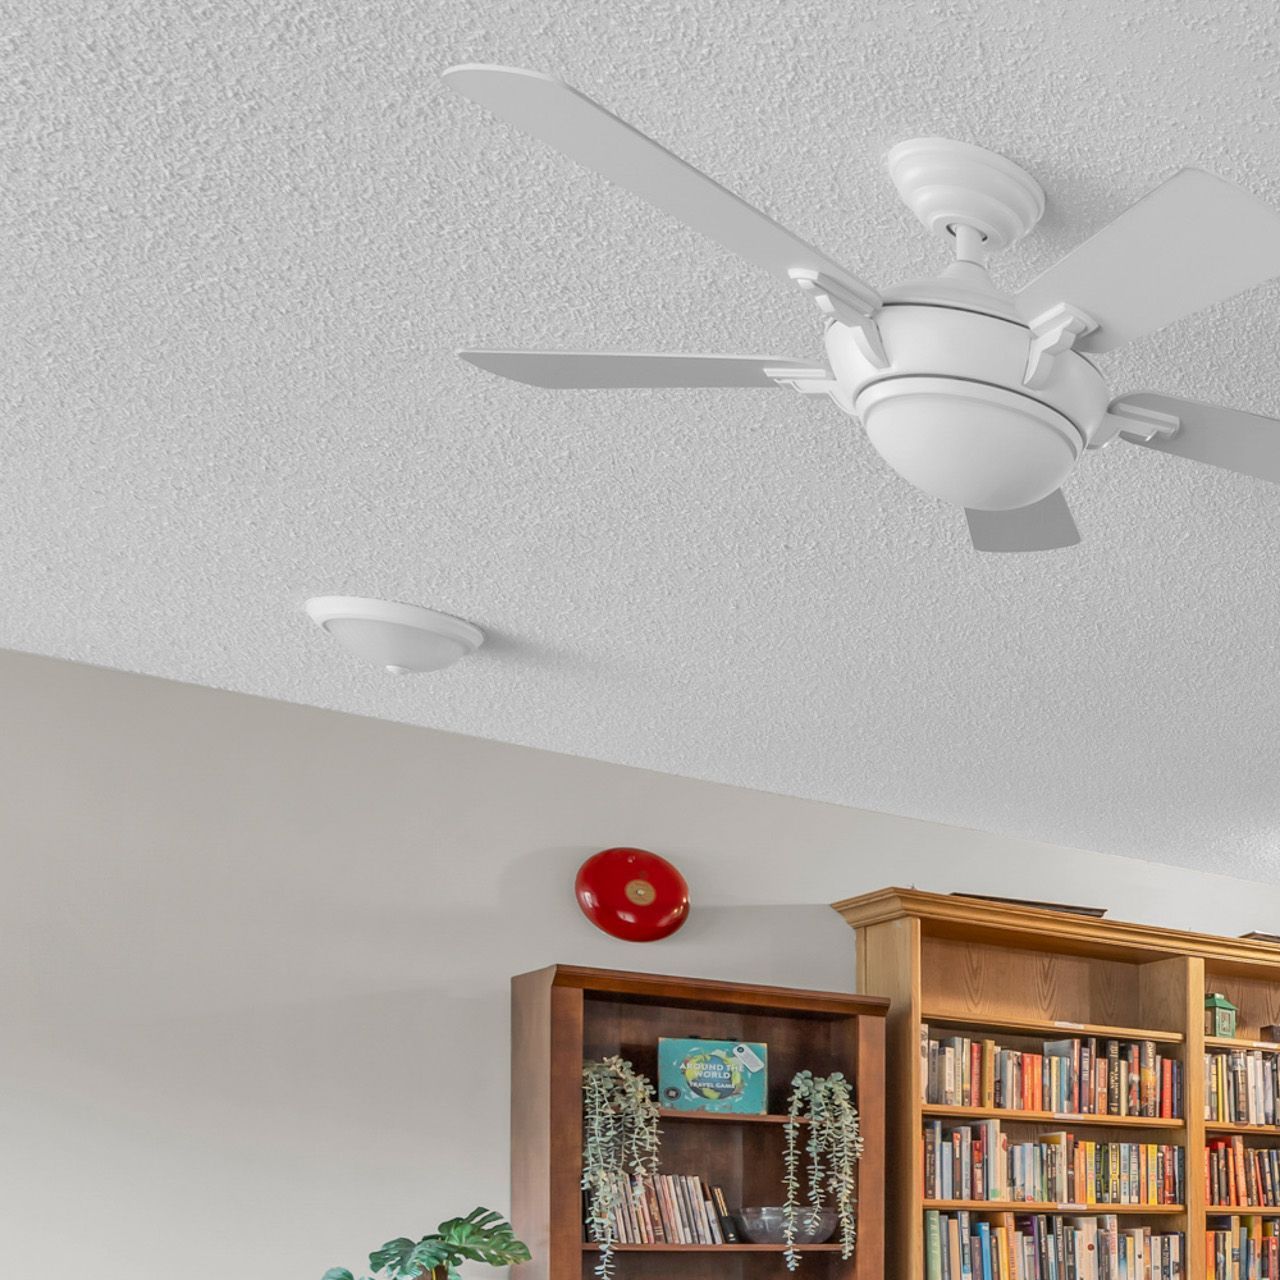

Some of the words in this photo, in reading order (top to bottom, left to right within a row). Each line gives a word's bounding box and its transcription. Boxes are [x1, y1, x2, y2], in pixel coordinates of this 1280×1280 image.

[680, 1063, 723, 1071] AROUND
[726, 1064, 745, 1072] THE
[694, 1071, 731, 1079] WORLD
